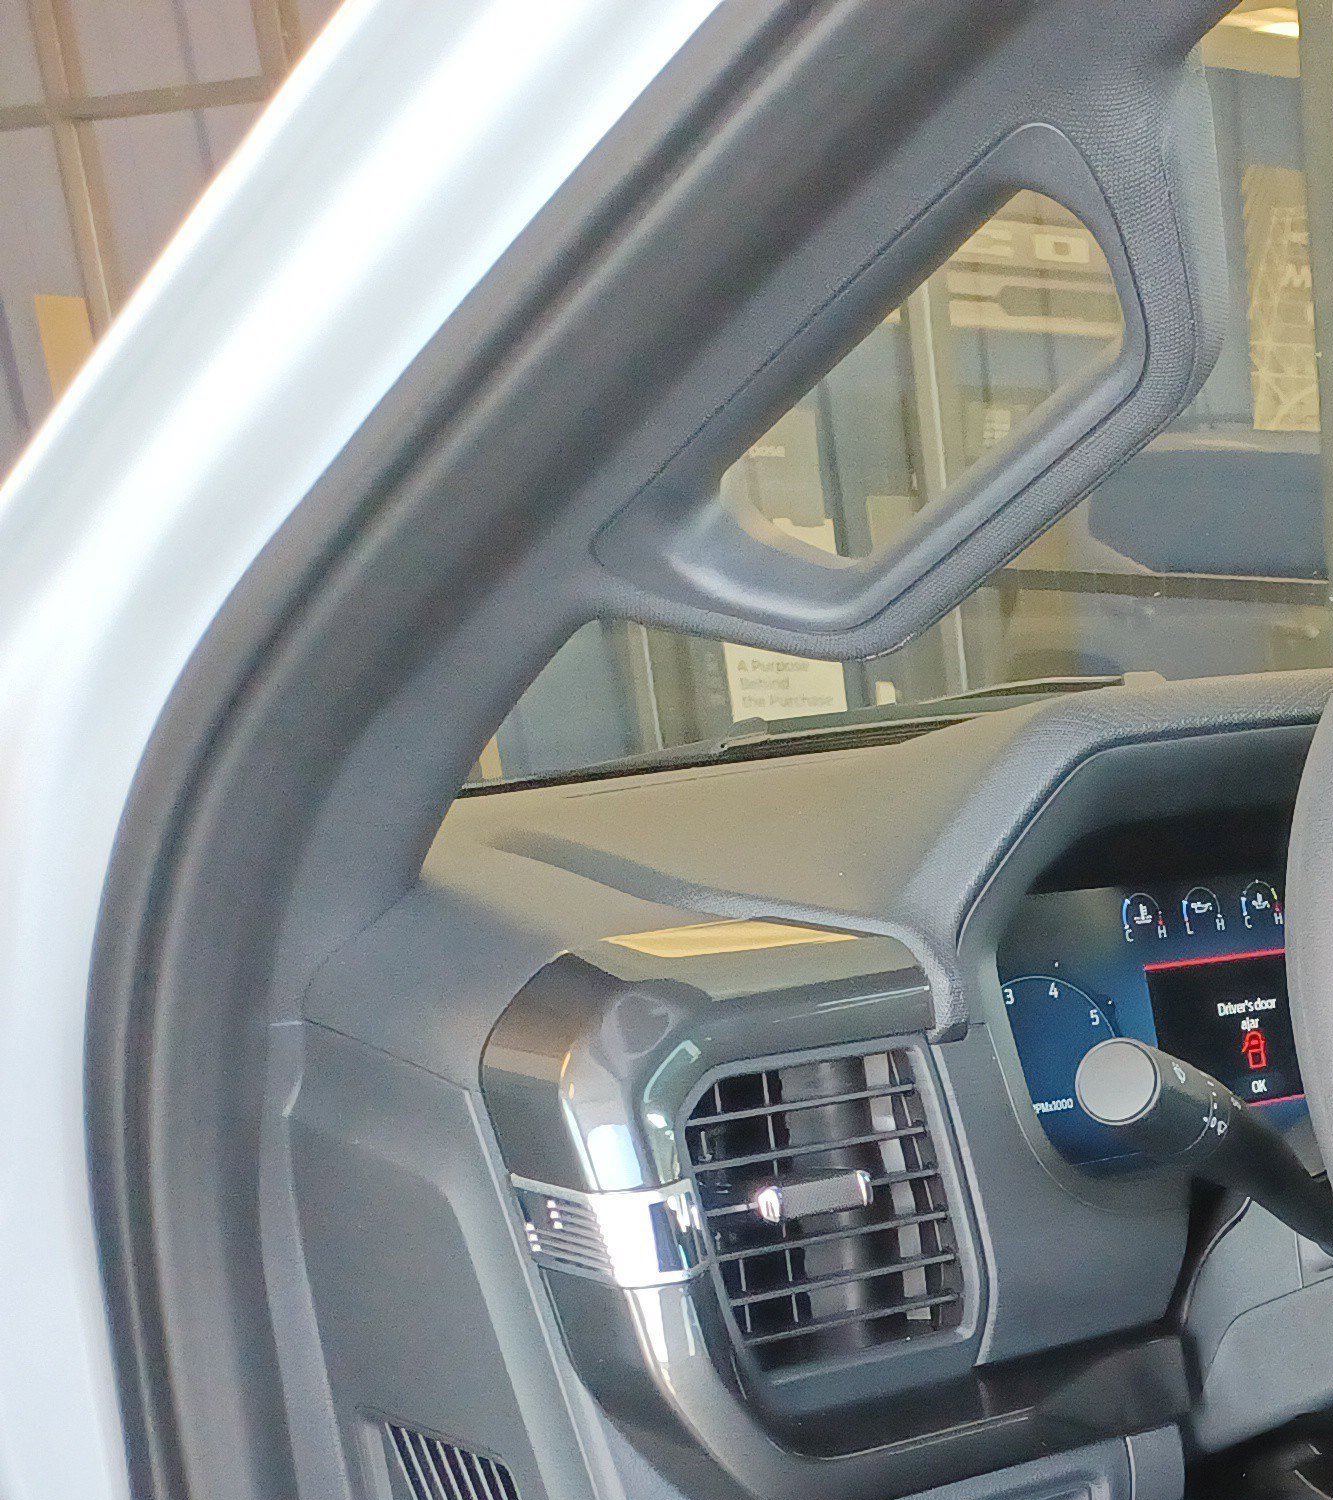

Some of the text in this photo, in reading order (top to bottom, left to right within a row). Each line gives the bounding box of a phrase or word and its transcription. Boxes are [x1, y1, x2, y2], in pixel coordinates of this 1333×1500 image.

[751, 660, 810, 674] Purpose
[1215, 917, 1226, 931] H
[1273, 912, 1284, 925] H
[1157, 925, 1168, 938] H
[1003, 988, 1015, 1005] 3
[1048, 982, 1059, 999] 4
[1217, 997, 1277, 1017] Driver's door
[1089, 1009, 1100, 1026] 5
[1241, 1017, 1260, 1032] ajar
[1251, 1079, 1268, 1093] OK
